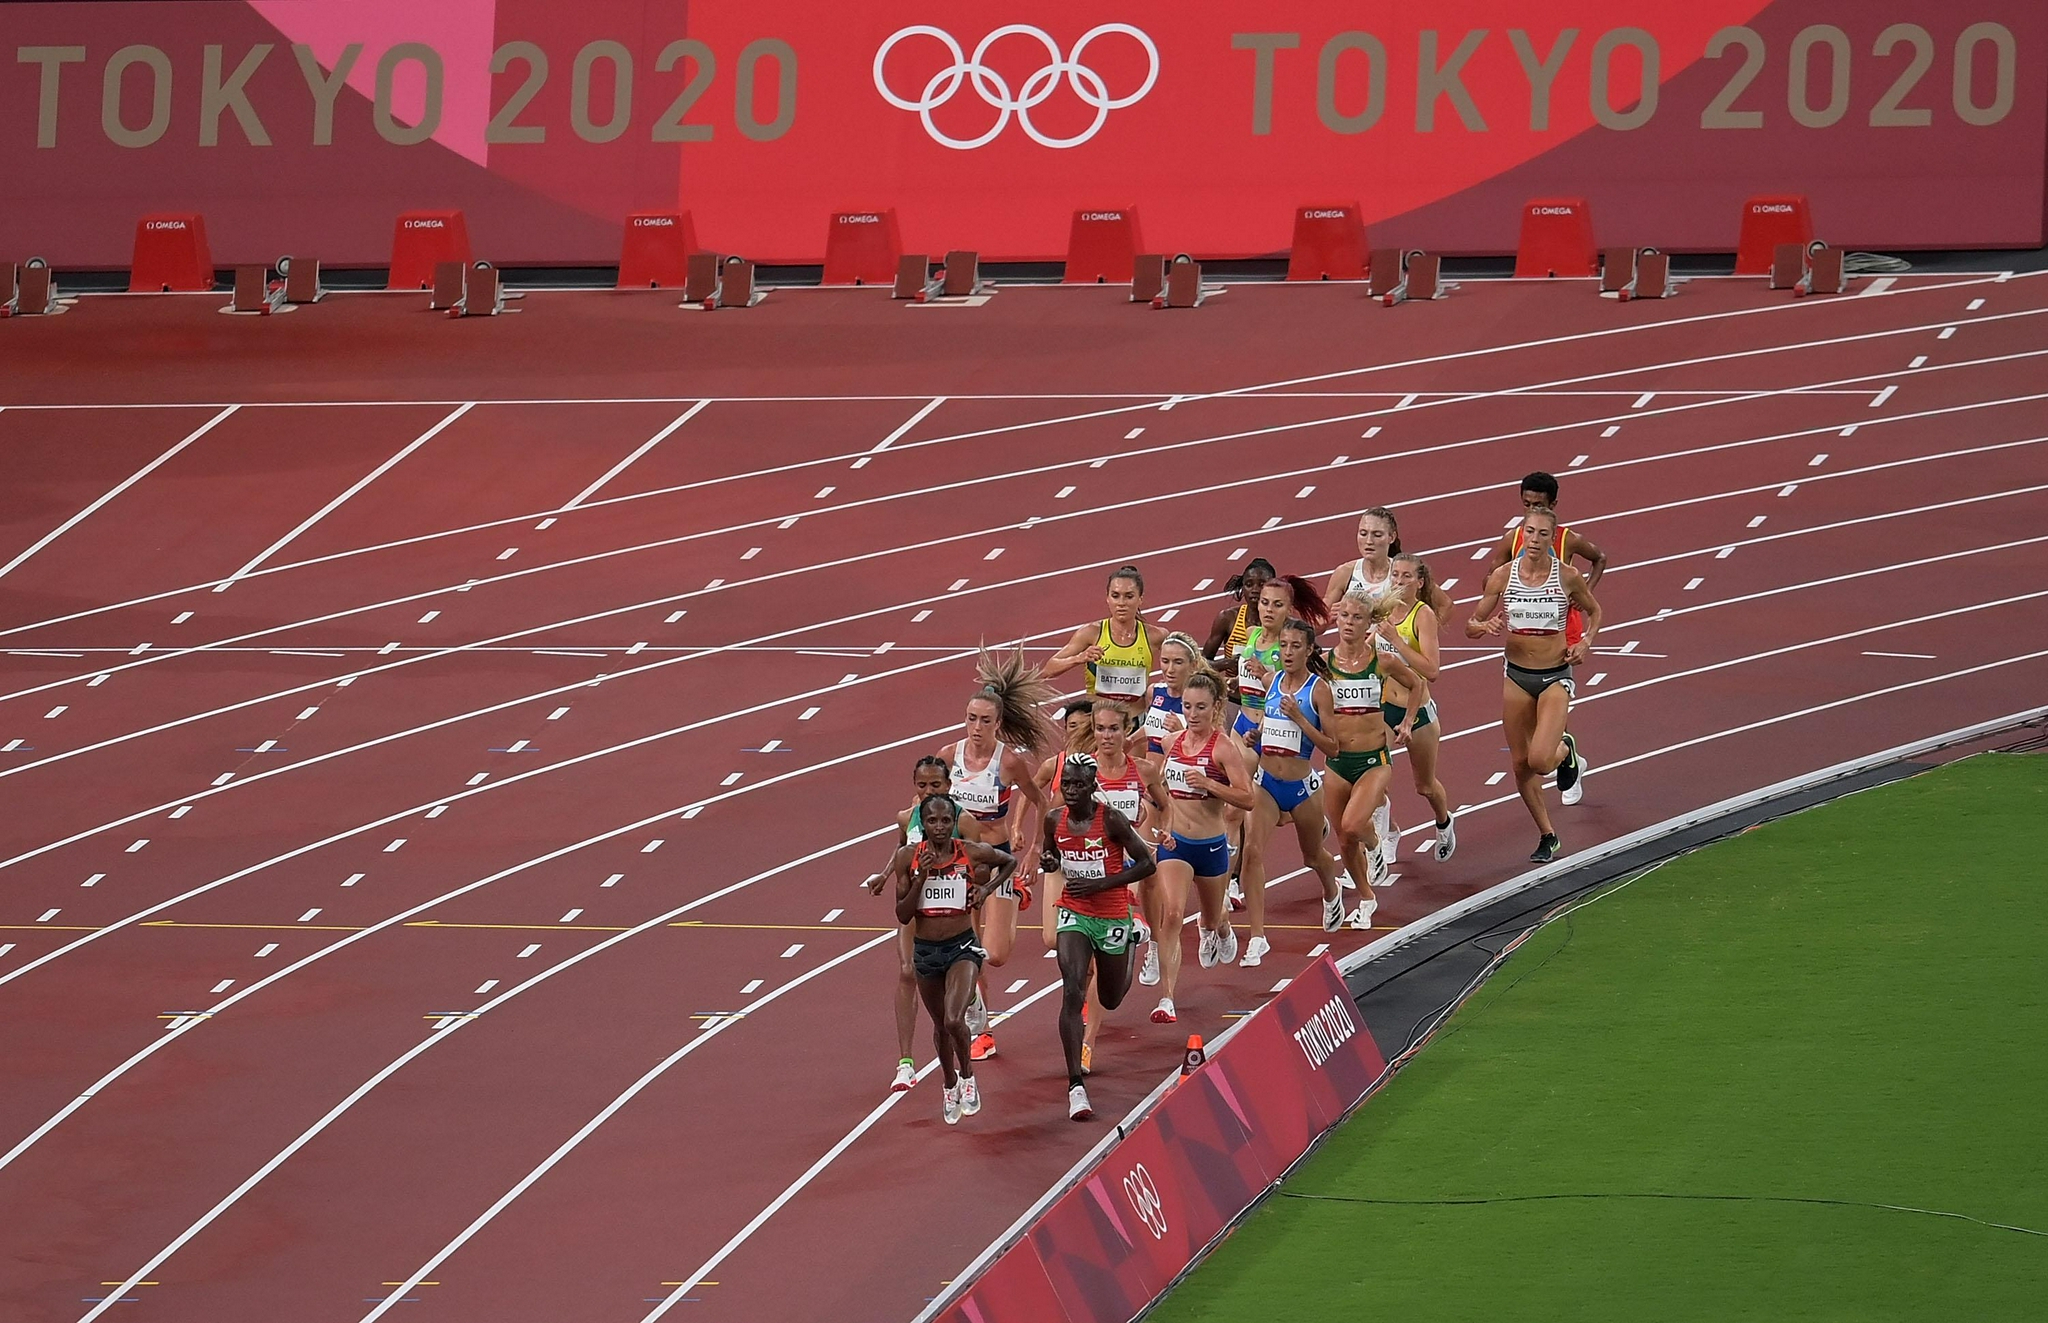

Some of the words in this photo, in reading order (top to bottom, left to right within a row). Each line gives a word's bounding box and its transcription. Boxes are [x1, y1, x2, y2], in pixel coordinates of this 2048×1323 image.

[1231, 27, 1662, 135] TOKYO
[1700, 22, 2017, 129] 2020
[17, 43, 445, 149] TOKYO
[486, 37, 799, 144] 2020
[1541, 206, 1572, 215] OMEGA
[1761, 204, 1793, 213] OMEGA
[1090, 212, 1122, 221] OMEGA
[1313, 210, 1345, 219] OMEGA
[642, 218, 674, 227] OMEGA
[848, 215, 879, 224] OMEGA
[155, 221, 186, 230] OMEGA
[413, 220, 444, 229] OMEGA
[1525, 611, 1556, 619] BUSKIRK
[1100, 658, 1146, 667] AUSTRALIA
[1100, 675, 1141, 685] BATT-DOYLE
[1336, 687, 1373, 699] SCOTT
[1309, 775, 1319, 791] 6
[1061, 847, 1109, 861] URUNDI
[925, 887, 955, 900] OBIRI
[1061, 909, 1071, 925] 9
[1112, 927, 1125, 943] 9
[1293, 1013, 1334, 1071] TOKYO
[1319, 994, 1356, 1049] 2020
